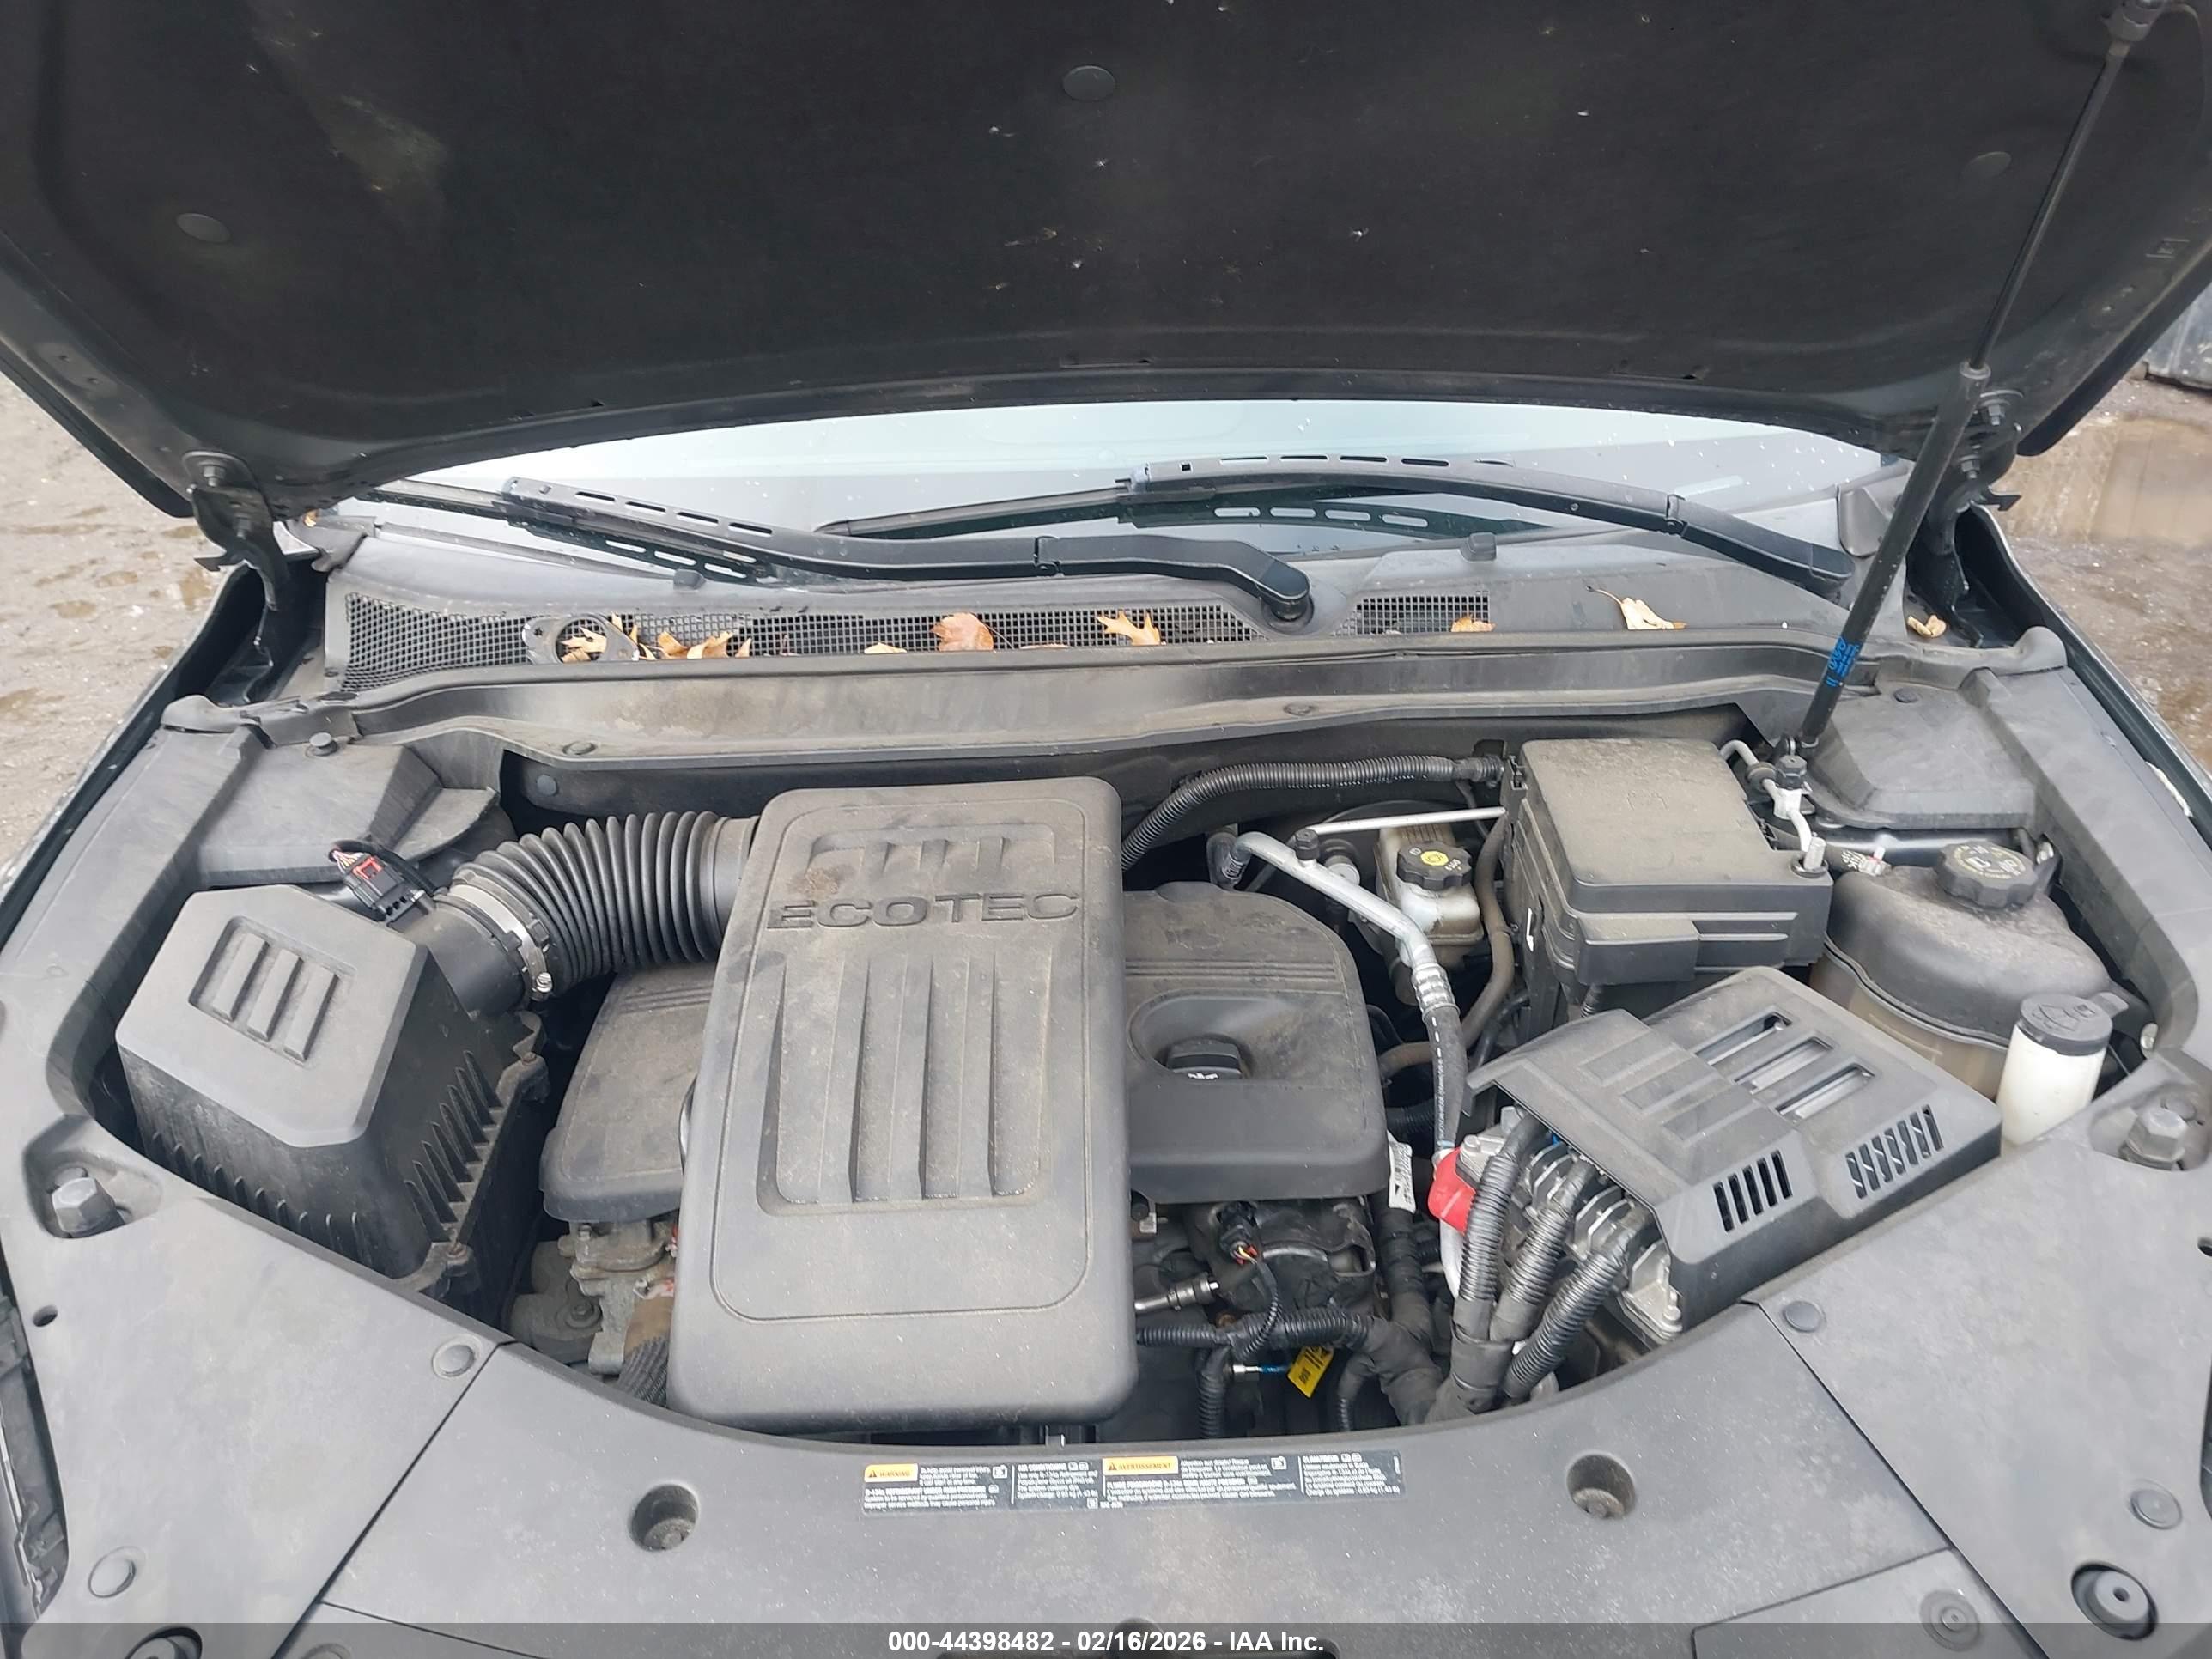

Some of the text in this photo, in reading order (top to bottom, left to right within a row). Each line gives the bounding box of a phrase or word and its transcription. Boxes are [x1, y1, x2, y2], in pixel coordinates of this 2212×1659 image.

[766, 893, 1080, 930] ECOTEC
[1118, 1462, 1171, 1471] AVERTISSEMENT
[879, 1469, 911, 1478] WARNING
